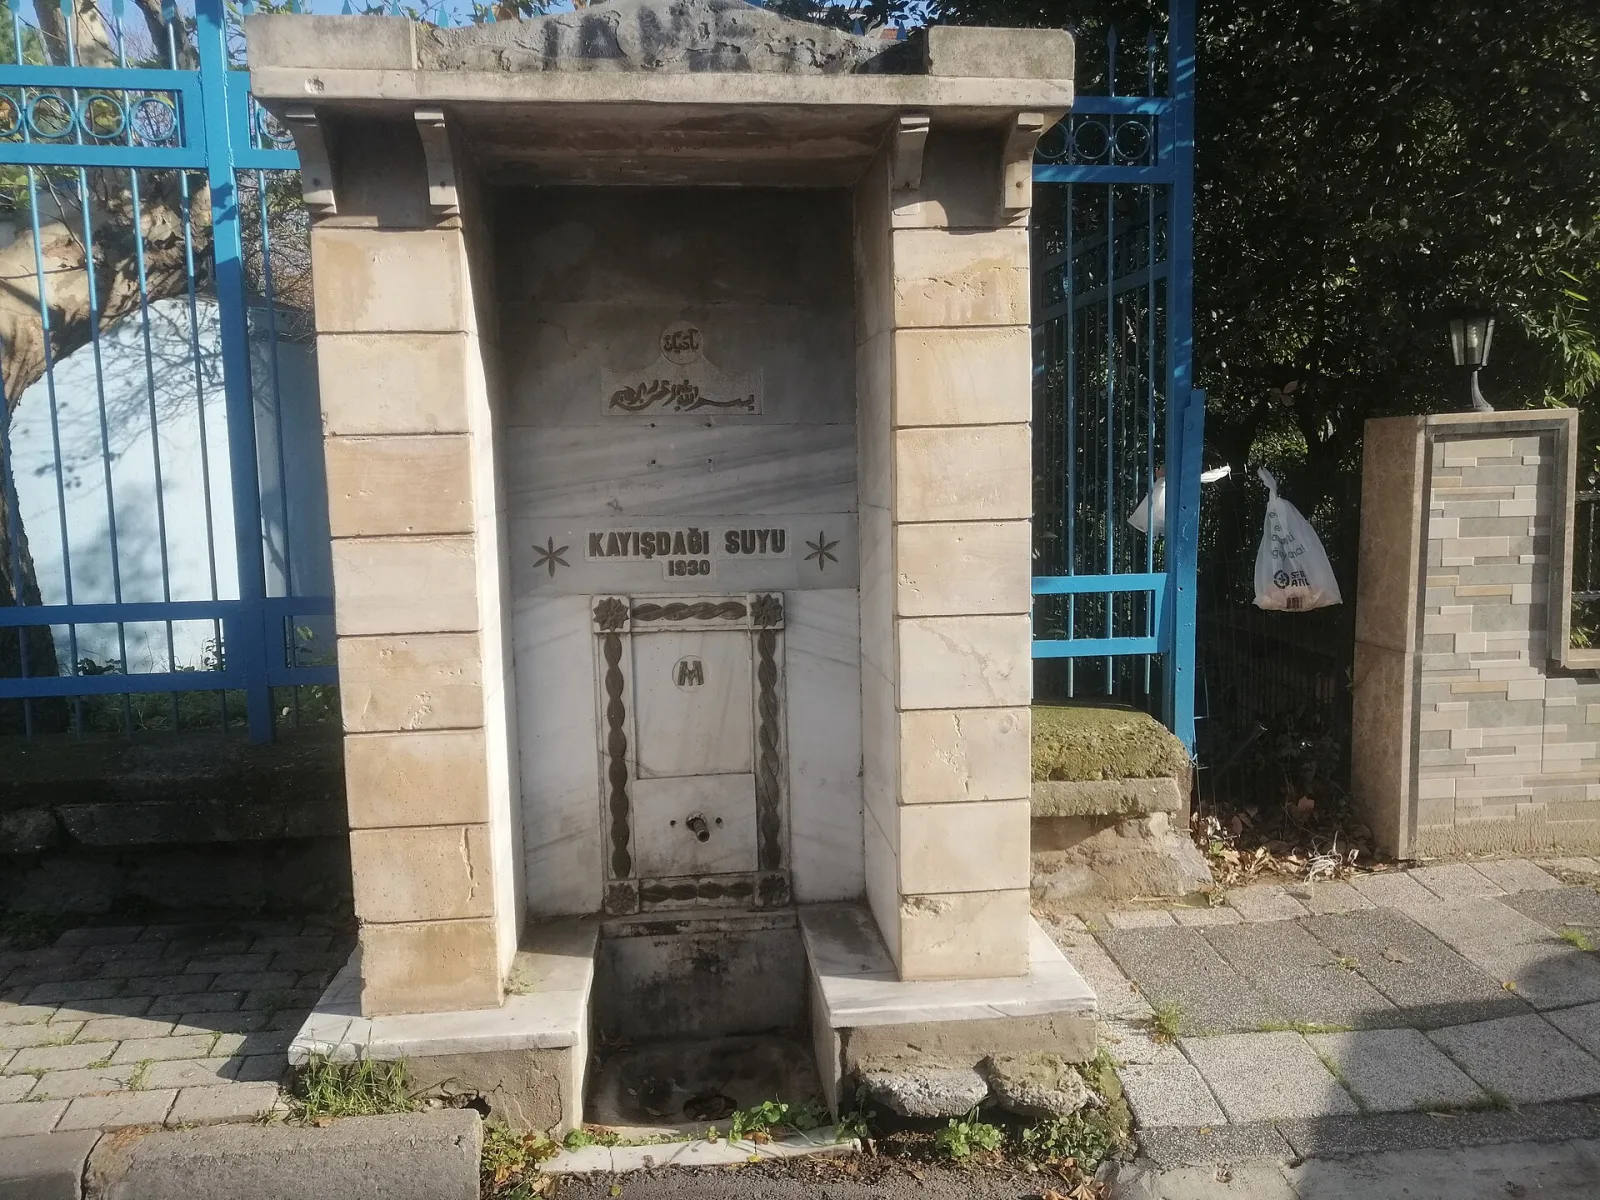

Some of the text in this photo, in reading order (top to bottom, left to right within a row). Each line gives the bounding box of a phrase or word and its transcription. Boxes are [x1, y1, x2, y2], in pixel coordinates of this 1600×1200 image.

[588, 527, 786, 559] KAYIŞDAĞI SUYU
[668, 559, 711, 577] 1930
